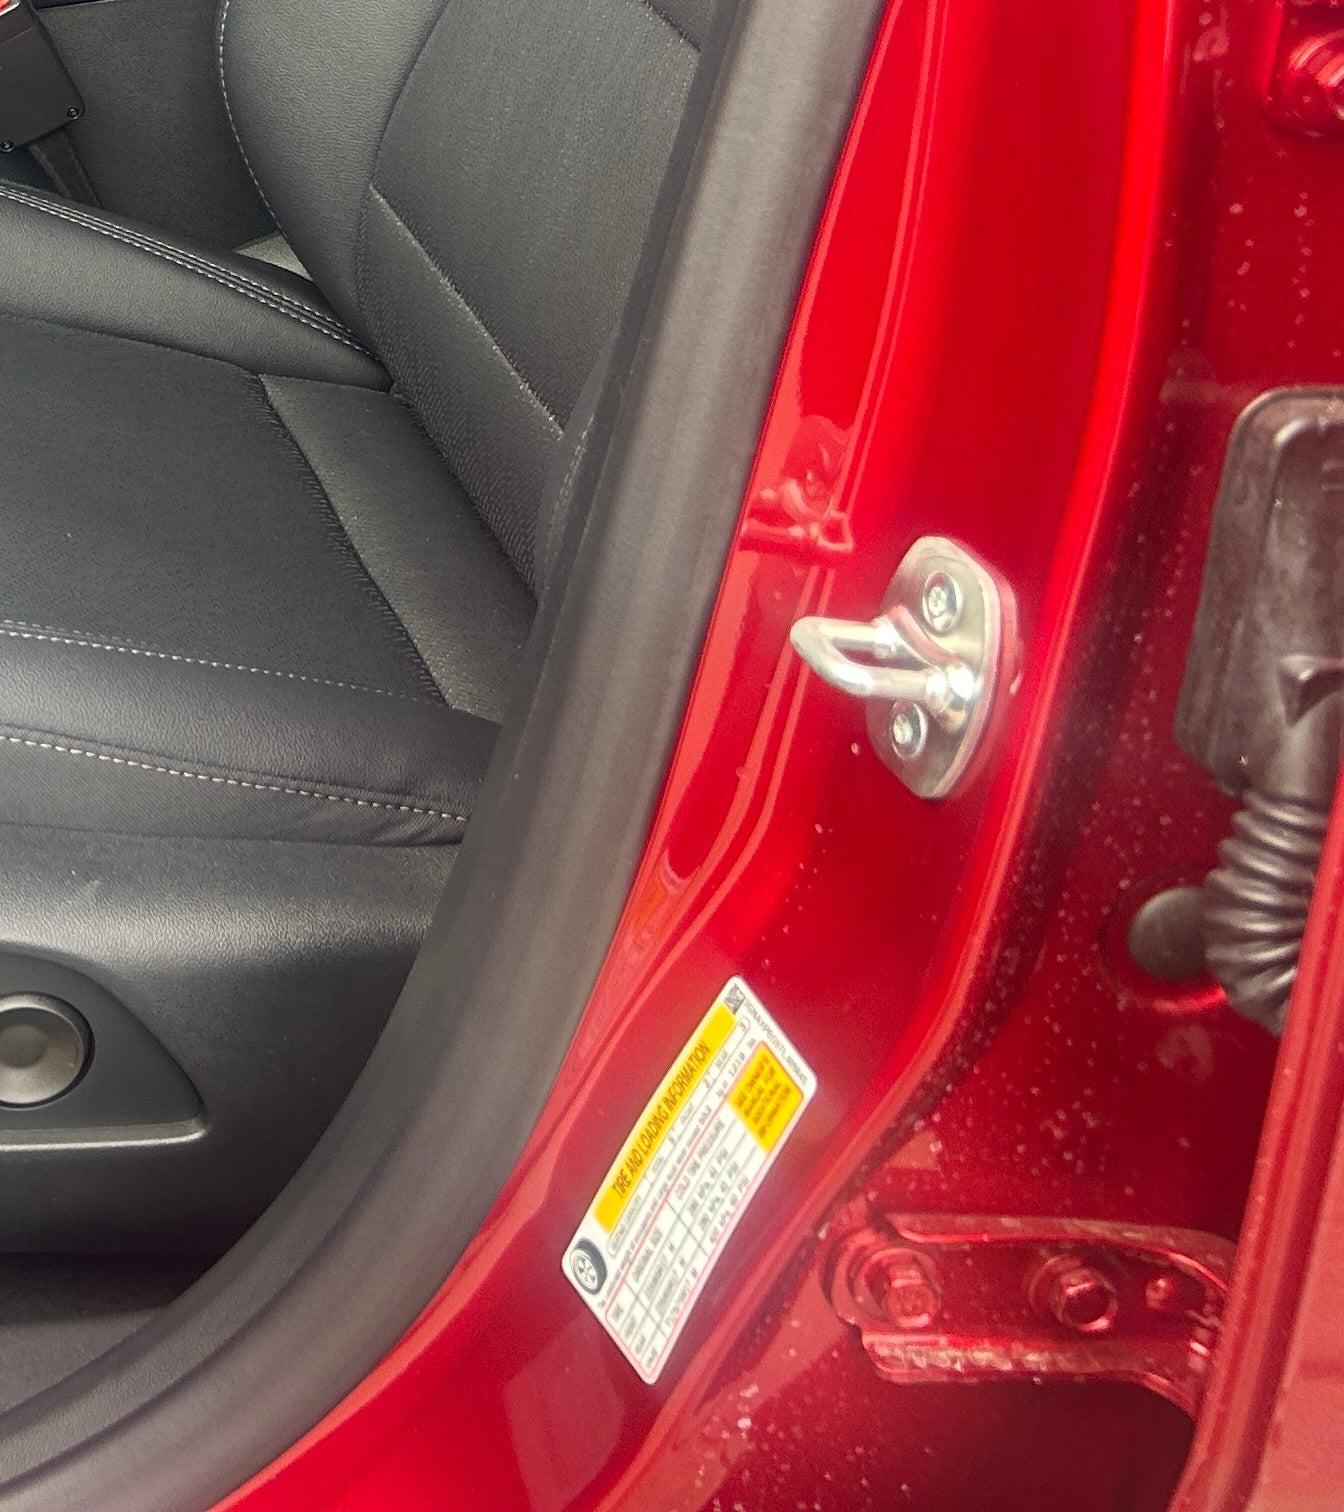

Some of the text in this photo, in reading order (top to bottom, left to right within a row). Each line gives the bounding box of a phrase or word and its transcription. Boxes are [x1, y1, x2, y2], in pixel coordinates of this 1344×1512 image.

[611, 1168, 632, 1199] TIRE
[624, 1146, 644, 1177] AND
[636, 1103, 670, 1156] LOADING
[662, 1036, 710, 1114] INFORMATION
